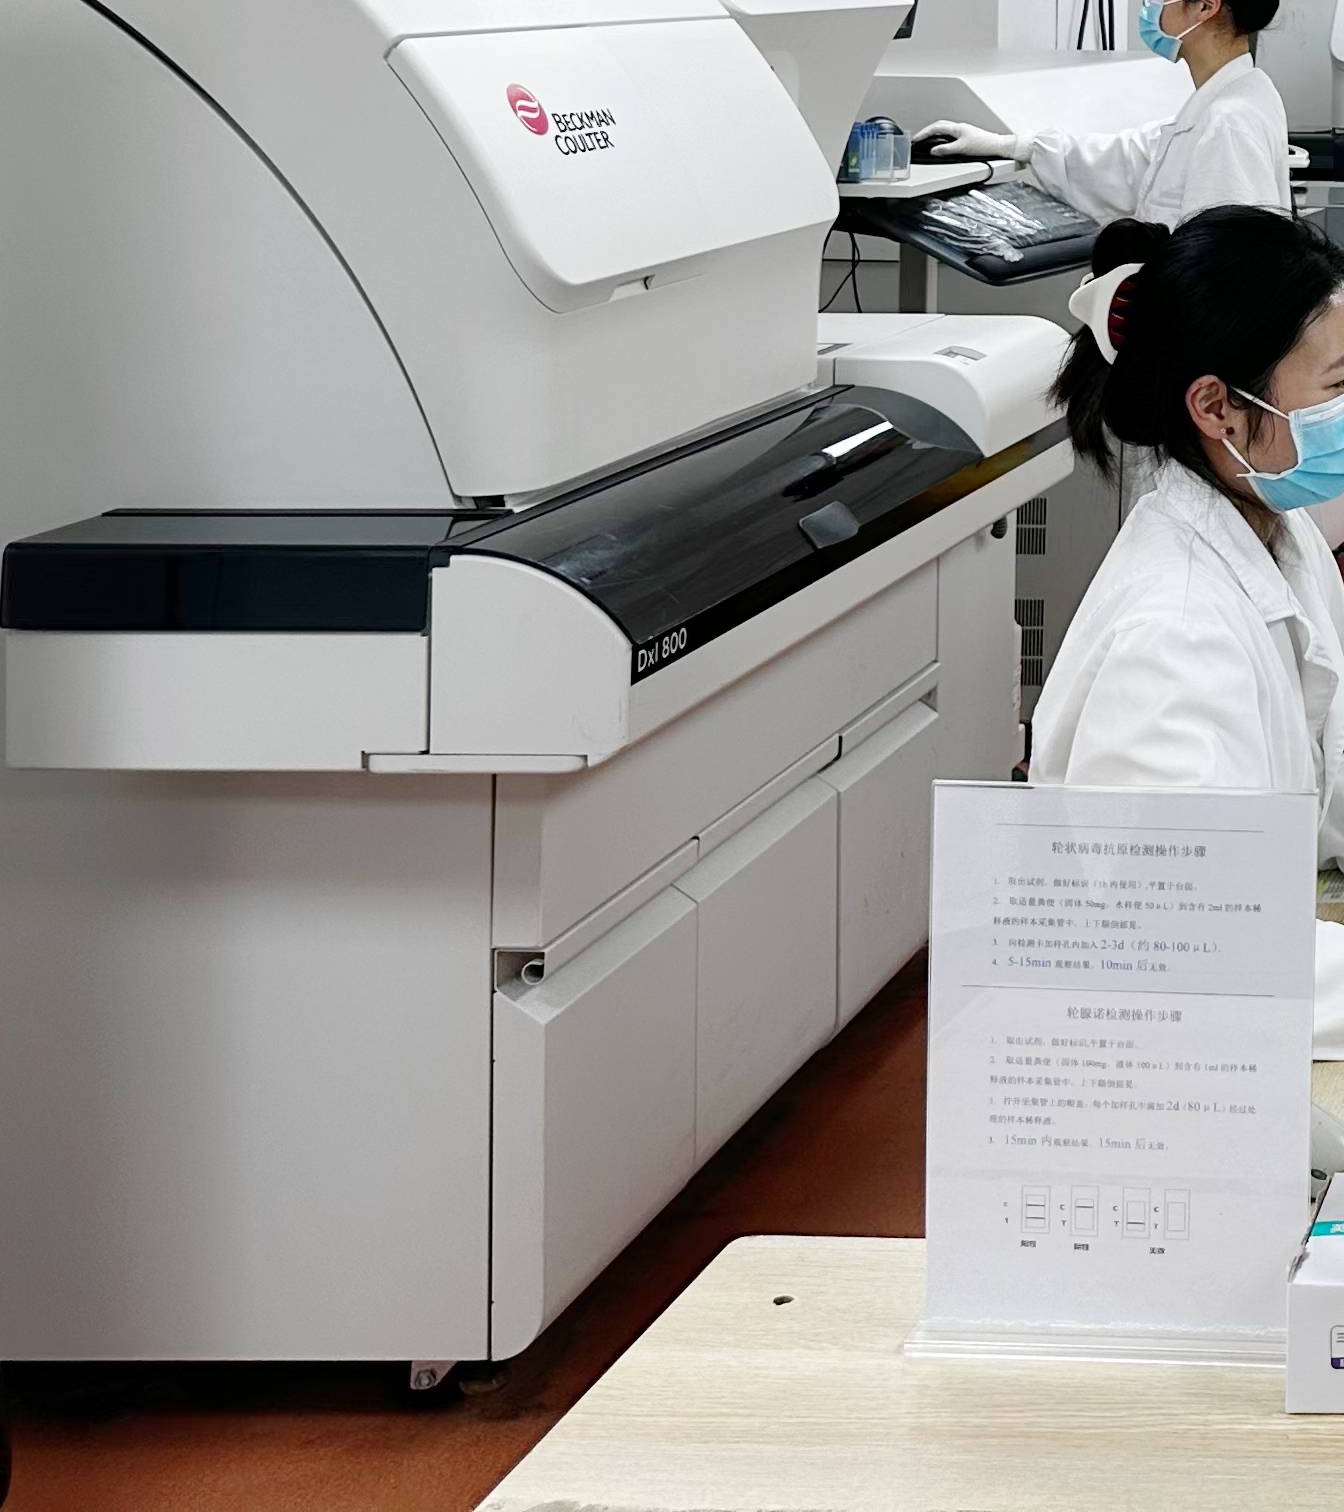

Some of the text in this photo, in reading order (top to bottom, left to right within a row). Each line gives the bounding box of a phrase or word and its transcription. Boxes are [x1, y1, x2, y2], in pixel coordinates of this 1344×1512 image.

[551, 108, 616, 133] BECKMAN
[555, 131, 615, 156] COULTER
[638, 627, 687, 673] DxI 800
[1051, 841, 1207, 858] 轮状病毒抗原检测操作步骤
[1067, 1006, 1183, 1023] 轮腺诺检测操作步骤
